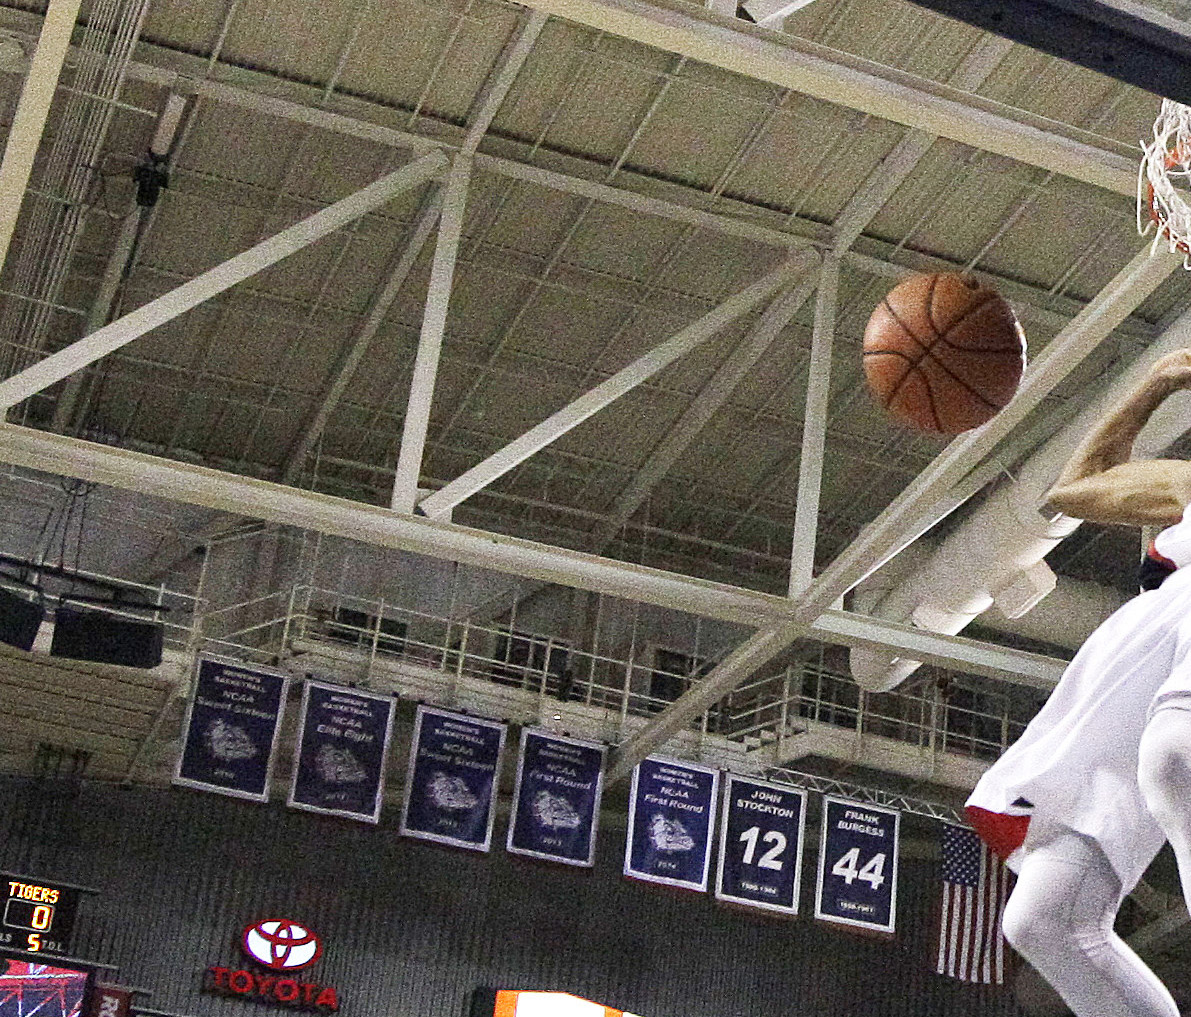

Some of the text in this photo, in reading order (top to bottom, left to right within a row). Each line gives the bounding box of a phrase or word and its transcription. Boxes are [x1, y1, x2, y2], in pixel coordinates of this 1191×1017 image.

[555, 777, 591, 790] Round
[660, 787, 688, 798] NCAA
[644, 794, 703, 813] First Round
[751, 790, 782, 804] JOHN
[737, 798, 793, 818] STOCKTON
[845, 810, 879, 824] FRANK
[838, 820, 884, 837] BURGESS
[739, 826, 786, 870] 12
[833, 847, 885, 889] 44
[8, 881, 60, 904] TIGERS
[31, 905, 51, 930] 0
[210, 966, 339, 1010] TOYOTA
